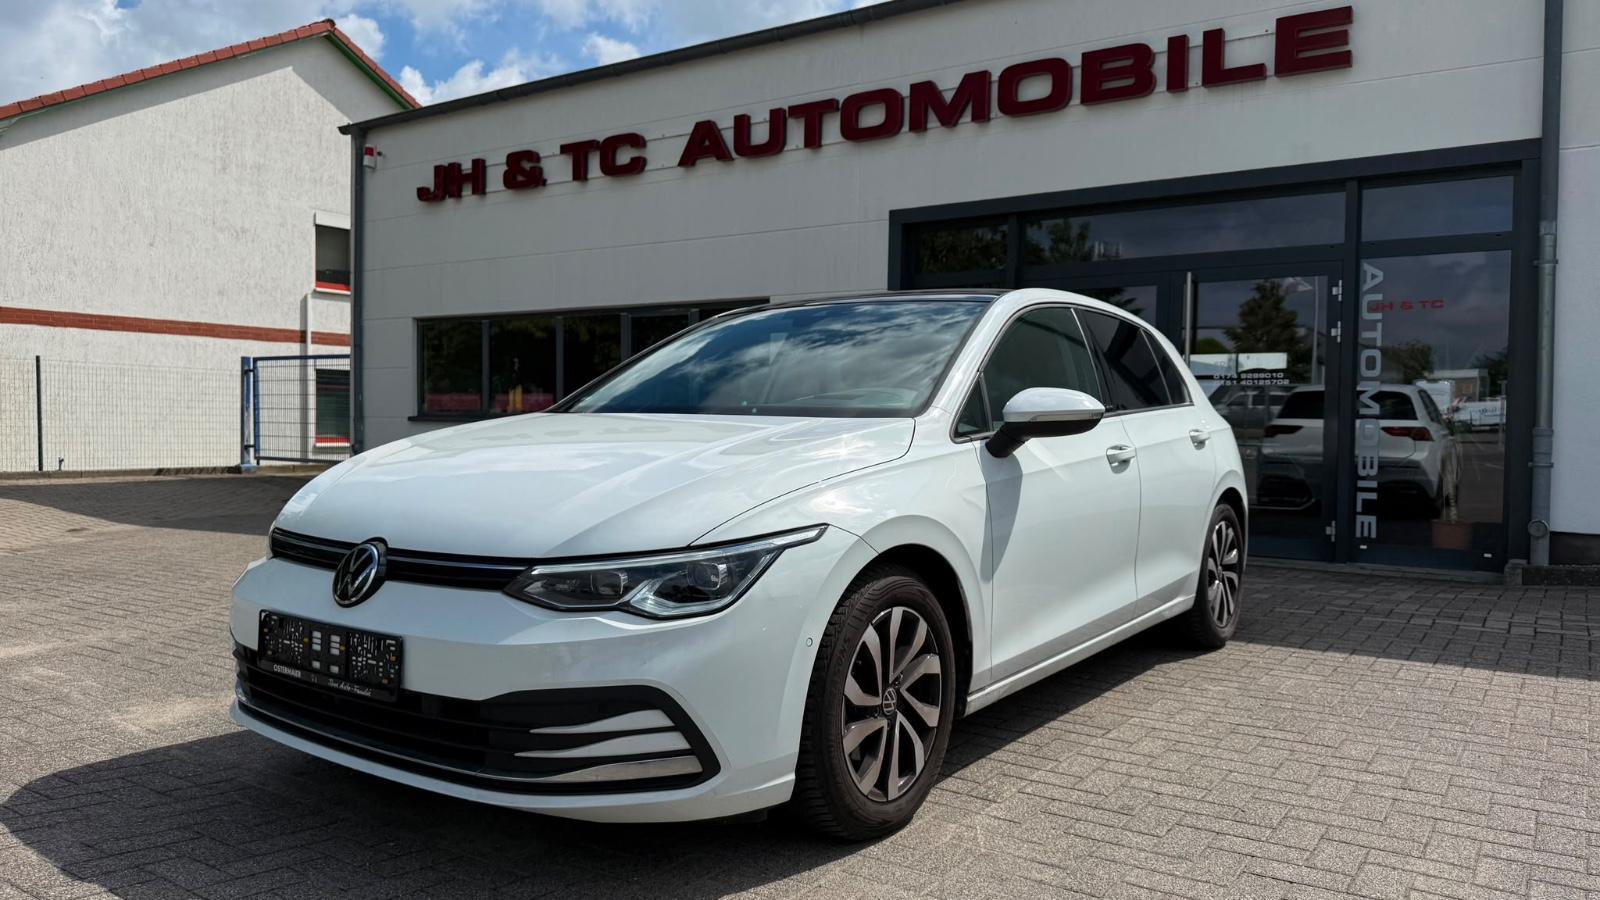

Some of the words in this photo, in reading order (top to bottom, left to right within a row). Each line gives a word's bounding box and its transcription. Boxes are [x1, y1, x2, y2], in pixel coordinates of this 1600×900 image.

[416, 158, 486, 202] JH
[503, 150, 547, 190] &
[560, 132, 648, 182] TC
[677, 5, 1353, 168] AUTOMOBILE
[1355, 262, 1384, 539] AUTOMOBILE
